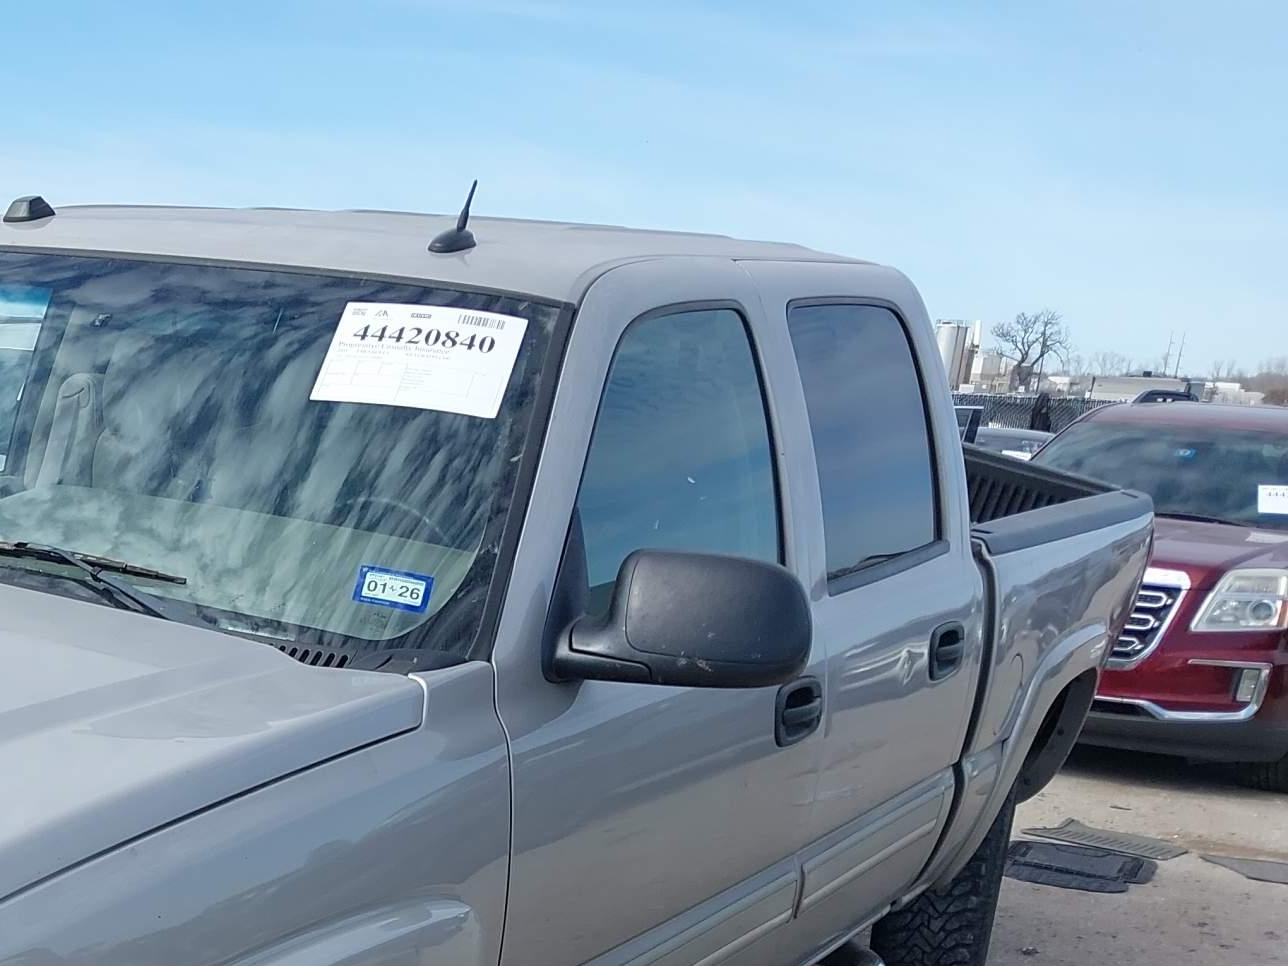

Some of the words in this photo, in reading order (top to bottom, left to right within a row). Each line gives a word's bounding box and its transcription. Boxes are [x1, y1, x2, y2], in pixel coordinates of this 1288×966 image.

[353, 324, 496, 354] 44420840
[367, 580, 388, 594] 01
[398, 585, 421, 600] 26
